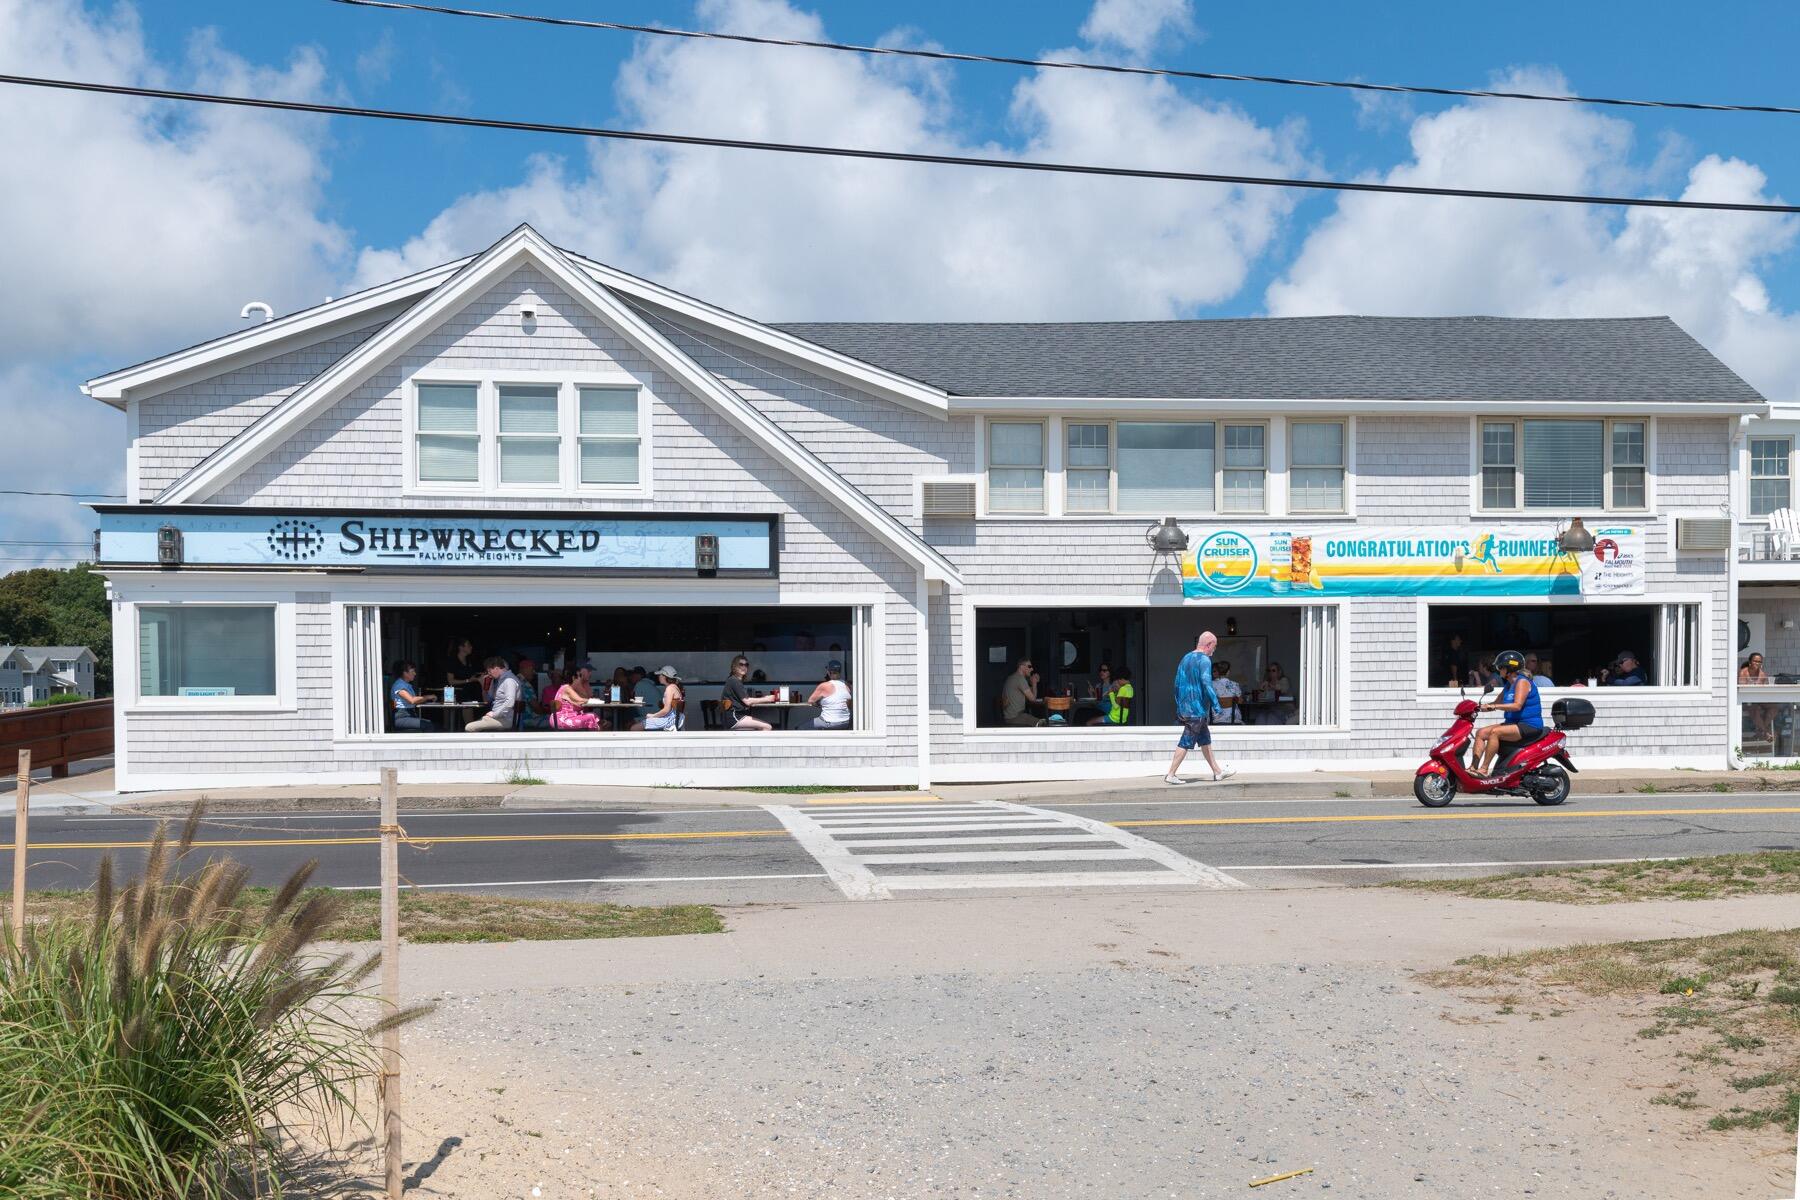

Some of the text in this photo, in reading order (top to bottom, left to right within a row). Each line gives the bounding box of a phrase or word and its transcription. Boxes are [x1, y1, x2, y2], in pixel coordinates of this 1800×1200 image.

[339, 520, 600, 555] SHIPWRECKED
[1215, 538, 1238, 546] SUN
[1204, 548, 1250, 556] CRUISER
[1498, 540, 1567, 557] RUNNER
[419, 552, 523, 561] FALMOUTH HEIGHTS
